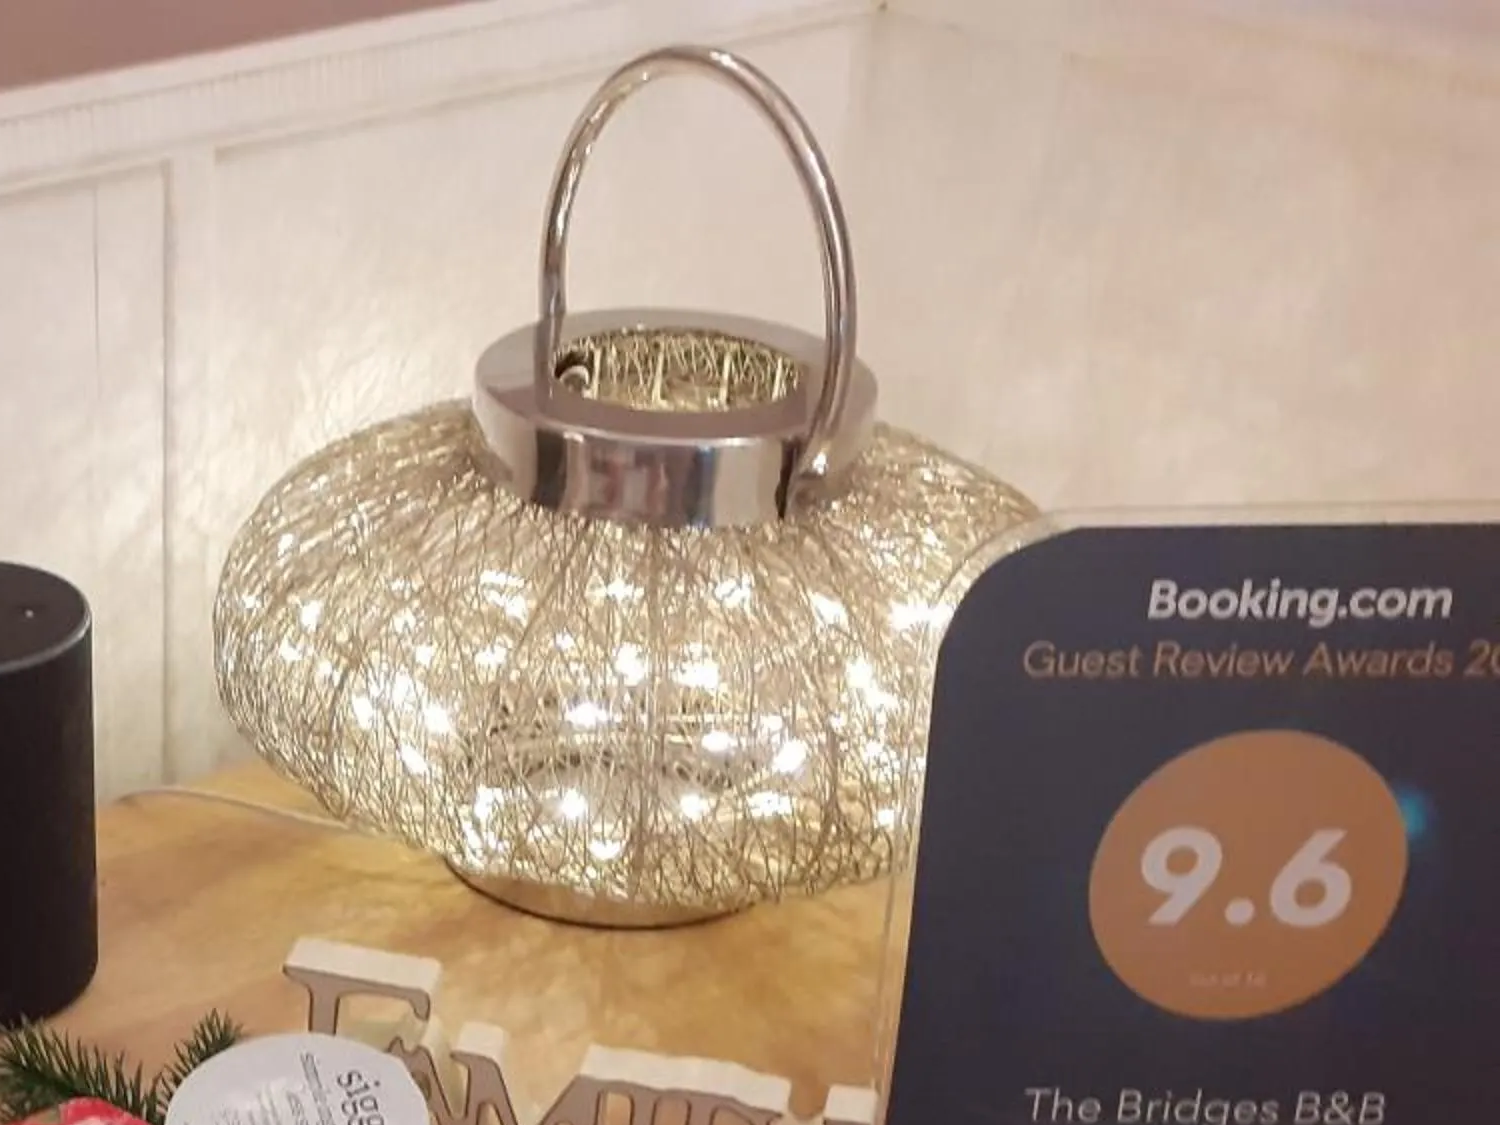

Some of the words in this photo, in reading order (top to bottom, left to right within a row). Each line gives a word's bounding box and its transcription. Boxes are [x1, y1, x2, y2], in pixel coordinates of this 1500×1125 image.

[1147, 579, 1453, 629] Booking.com
[1022, 641, 1141, 679] Guest
[1152, 641, 1296, 678] Review
[1303, 640, 1455, 678] Awards
[1140, 826, 1353, 928] 9.6
[1025, 1088, 1101, 1125] The
